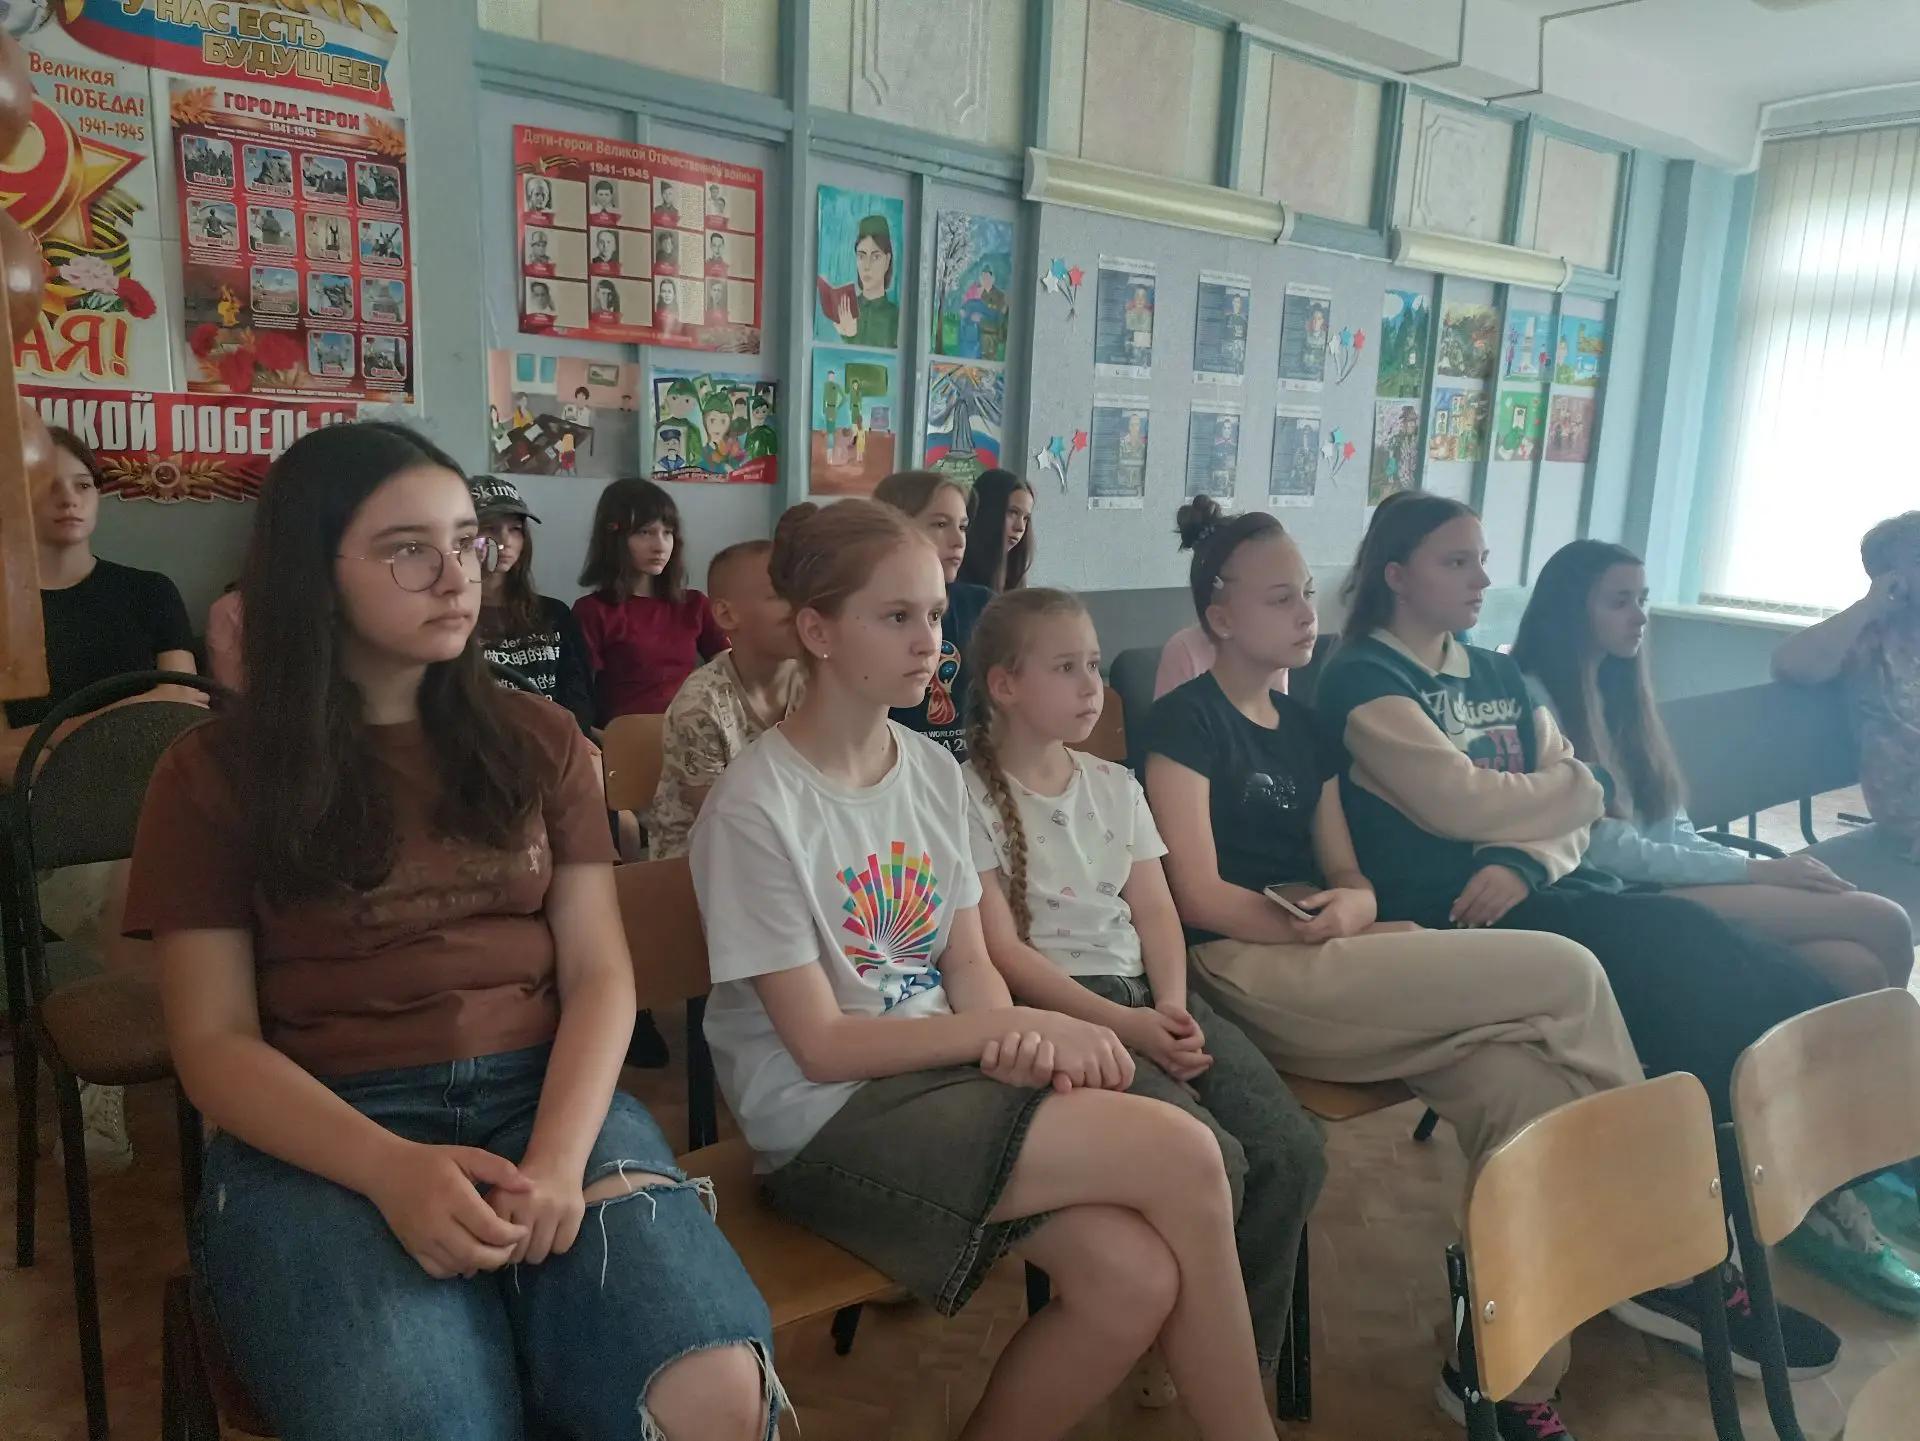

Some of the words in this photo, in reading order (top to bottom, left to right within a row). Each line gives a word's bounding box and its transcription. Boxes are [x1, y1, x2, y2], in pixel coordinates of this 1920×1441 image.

[156, 0, 230, 32] НАС
[237, 7, 325, 47] ЕСТЬ
[28, 51, 115, 87] Великая
[203, 33, 382, 92] БУДУЩЕЕ!
[54, 83, 145, 117] ПОБЕДА!
[223, 91, 360, 130] ГОРОДА-ГЕРОИ
[78, 116, 145, 141] 1941-1945
[269, 122, 317, 138] 1941-1945
[523, 129, 593, 152] Дети-герои
[596, 140, 646, 160] Великой
[648, 149, 722, 177] Отечественной
[724, 164, 756, 184] войны
[23, 393, 157, 451] ИКОЙ
[928, 729, 955, 738] WORLD
